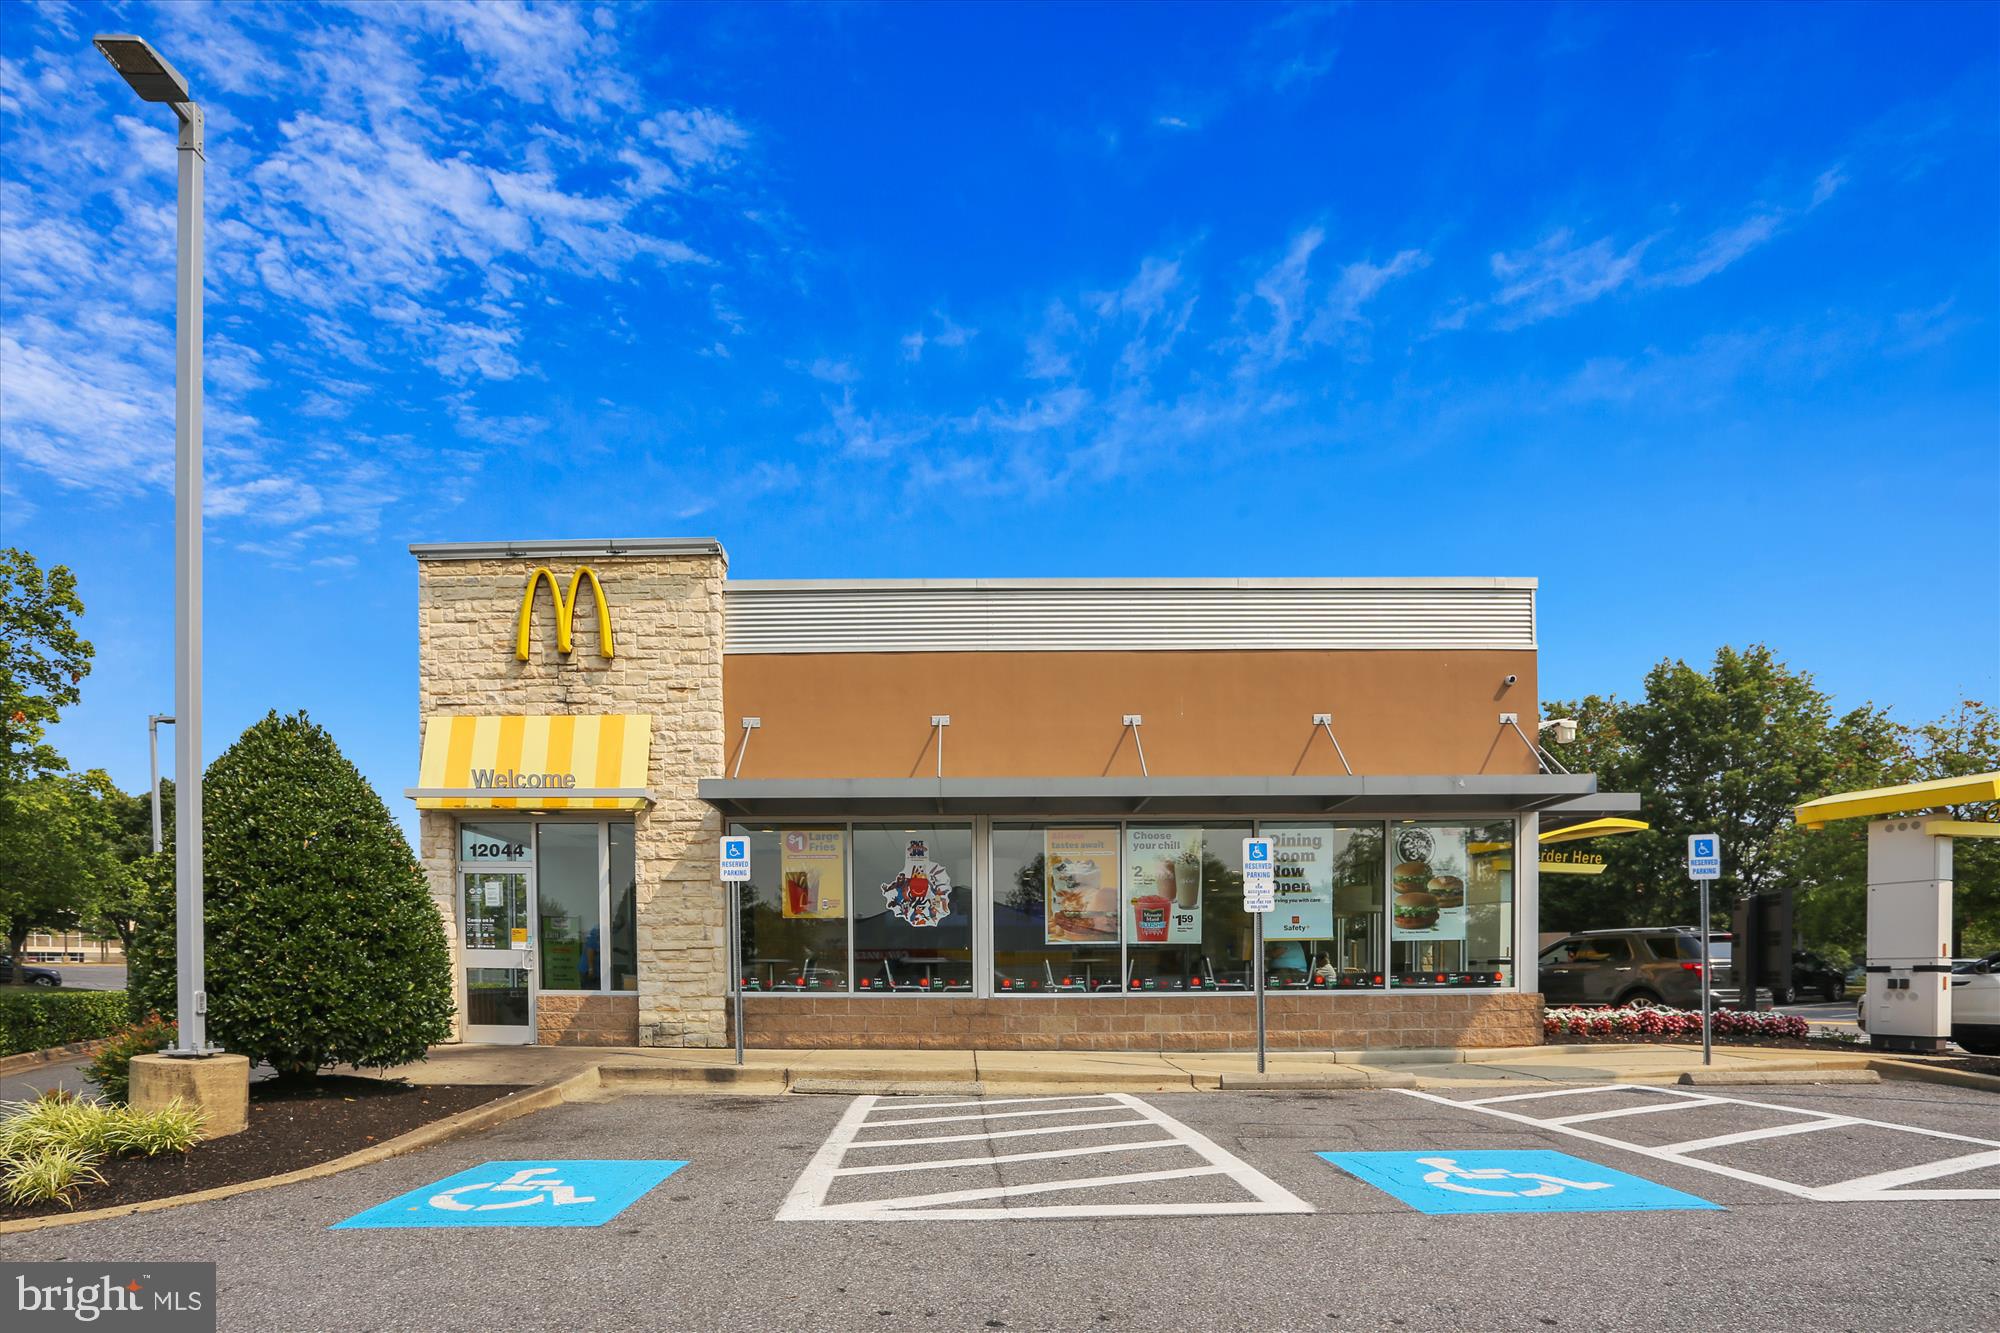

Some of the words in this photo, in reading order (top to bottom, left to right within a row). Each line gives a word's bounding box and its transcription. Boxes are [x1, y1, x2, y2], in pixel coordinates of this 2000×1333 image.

[471, 769, 576, 788] Welcome
[788, 834, 804, 850] $1
[809, 832, 840, 843] Large
[1133, 832, 1172, 840] Choose
[470, 844, 524, 857] 12044
[809, 843, 836, 851] Fries
[1133, 842, 1156, 851] your
[1158, 841, 1181, 849] chill
[1540, 850, 1568, 862] rder
[1573, 851, 1602, 864] Here
